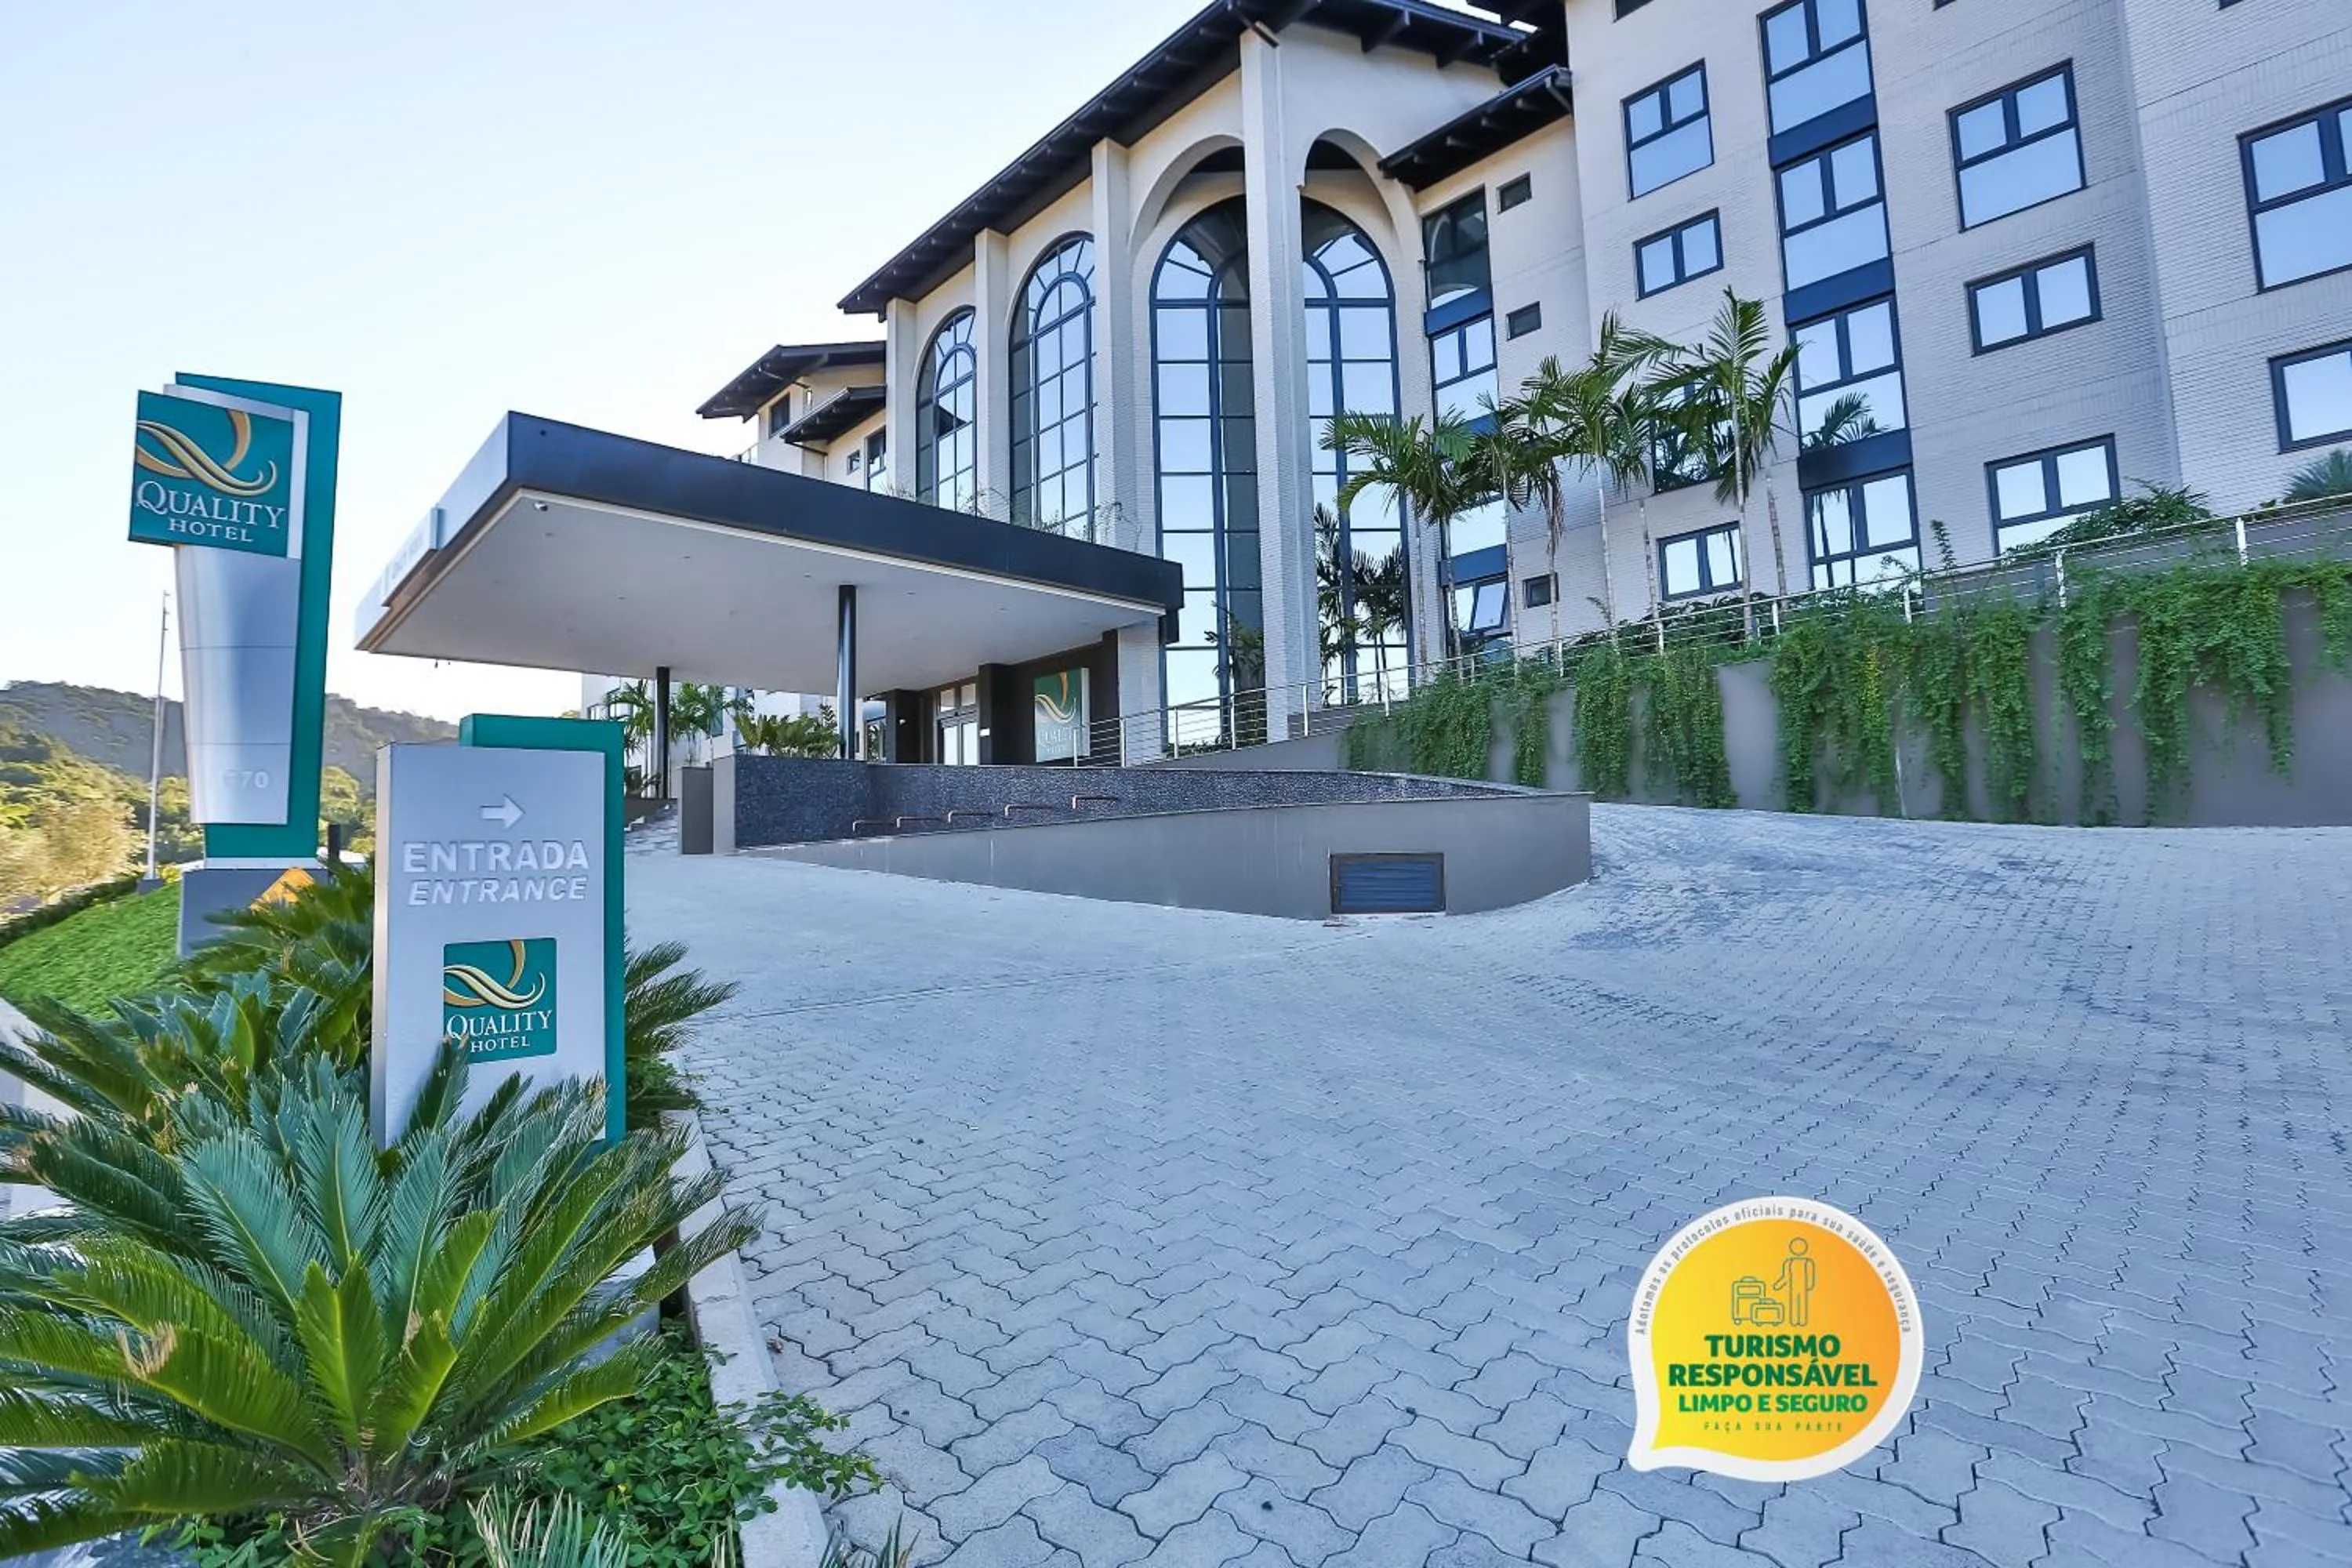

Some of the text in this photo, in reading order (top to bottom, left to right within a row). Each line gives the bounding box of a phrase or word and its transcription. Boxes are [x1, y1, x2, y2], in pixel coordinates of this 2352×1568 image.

[136, 480, 286, 529] QUALITY
[168, 517, 254, 543] HOTEL
[402, 840, 590, 873] ENTRADA
[408, 876, 588, 906] ENTRANCE
[446, 1009, 552, 1041] QUALITY
[470, 1036, 530, 1053] HOTEL
